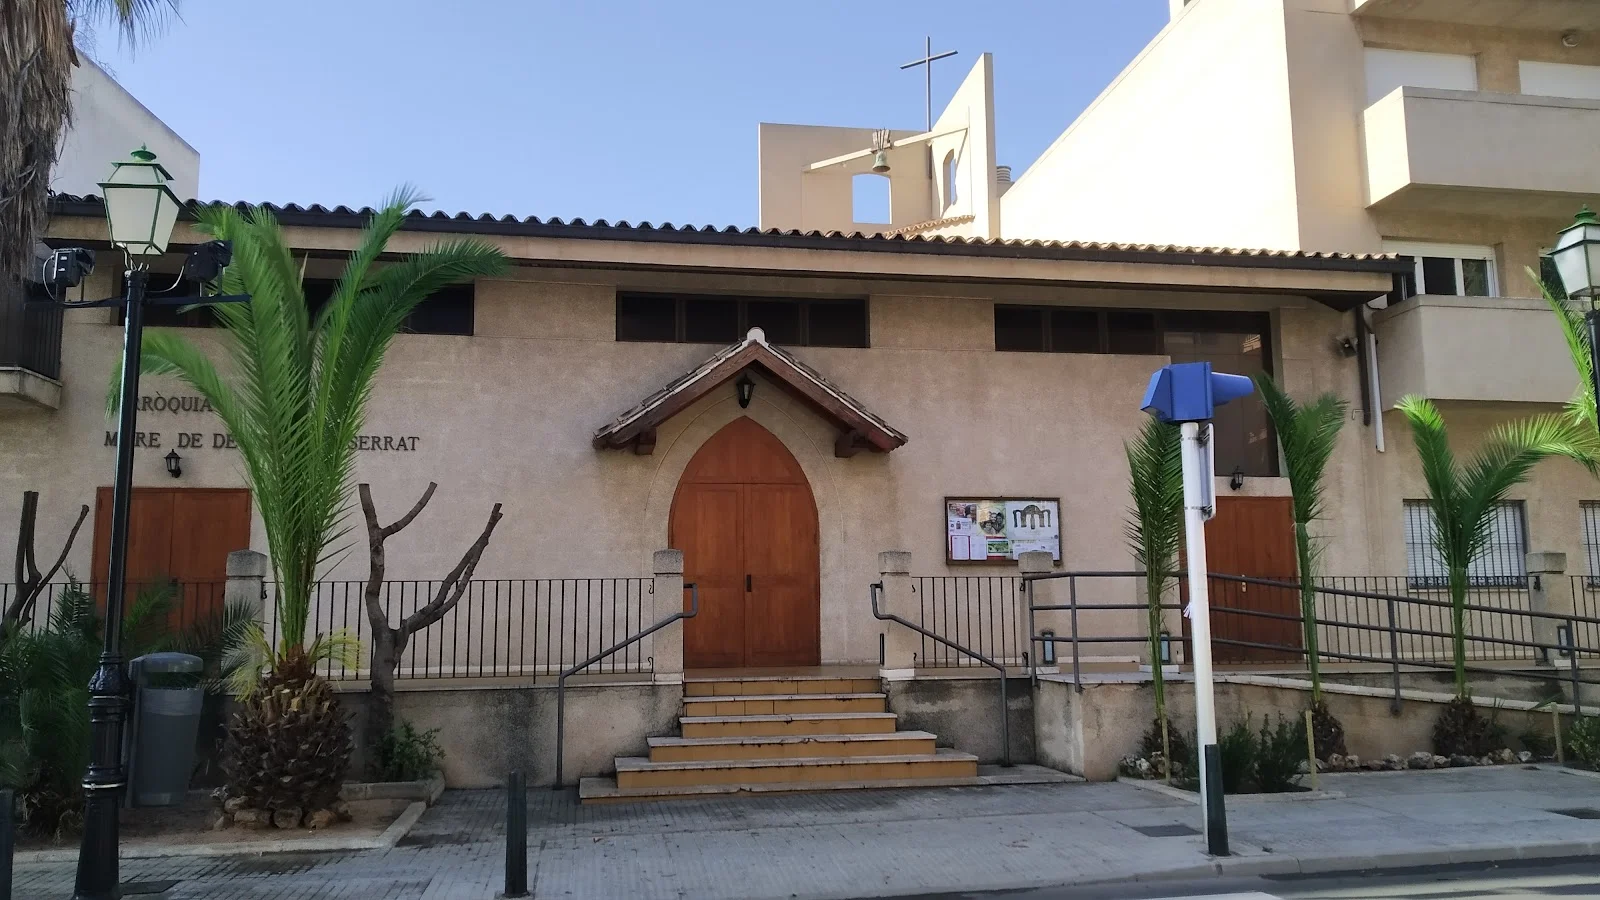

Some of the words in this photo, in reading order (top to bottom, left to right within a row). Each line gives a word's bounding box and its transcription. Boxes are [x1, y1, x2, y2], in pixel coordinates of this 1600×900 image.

[136, 391, 213, 414] RÒQUIA
[103, 431, 161, 449] MRE
[177, 432, 203, 448] DE
[212, 433, 237, 449] DE
[348, 435, 420, 451] SERRAT
